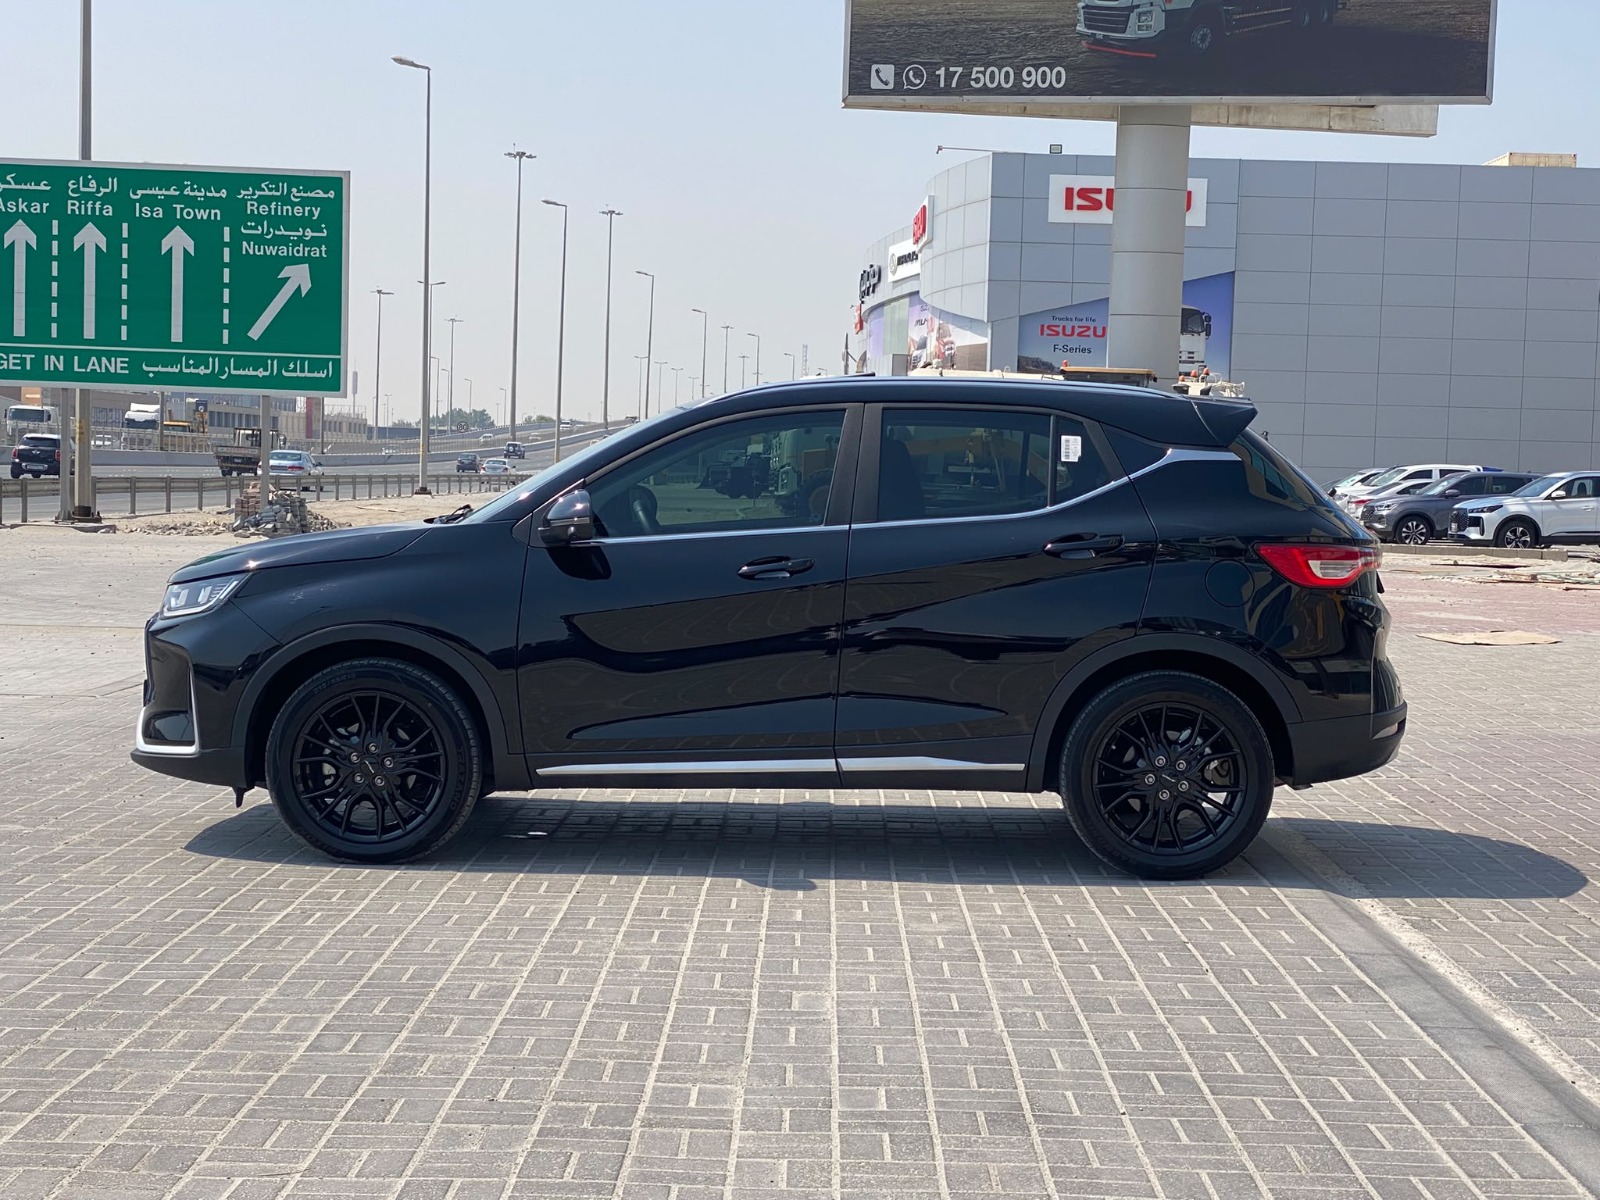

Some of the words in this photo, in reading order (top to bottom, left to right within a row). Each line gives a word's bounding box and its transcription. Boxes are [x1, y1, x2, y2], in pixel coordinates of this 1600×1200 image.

[935, 66, 963, 88] 17
[970, 66, 1015, 89] 500
[1021, 66, 1066, 89] 900
[68, 174, 118, 197] الرفاع
[129, 185, 180, 199] عيسى
[183, 181, 227, 201] مدينة
[236, 181, 287, 199] التكرير
[290, 186, 335, 202] مصنع
[67, 200, 113, 216] Riffa
[135, 202, 163, 218] Isa
[172, 204, 221, 221] Town
[247, 201, 321, 220] Refinery
[240, 220, 327, 240] نويدرات
[242, 241, 327, 259] Nuwaidrat
[1040, 323, 1107, 339] ISUZU
[1053, 344, 1092, 354] F-Series
[44, 355, 64, 372] IN
[74, 356, 129, 374] LANE
[281, 360, 333, 378] اسلك
